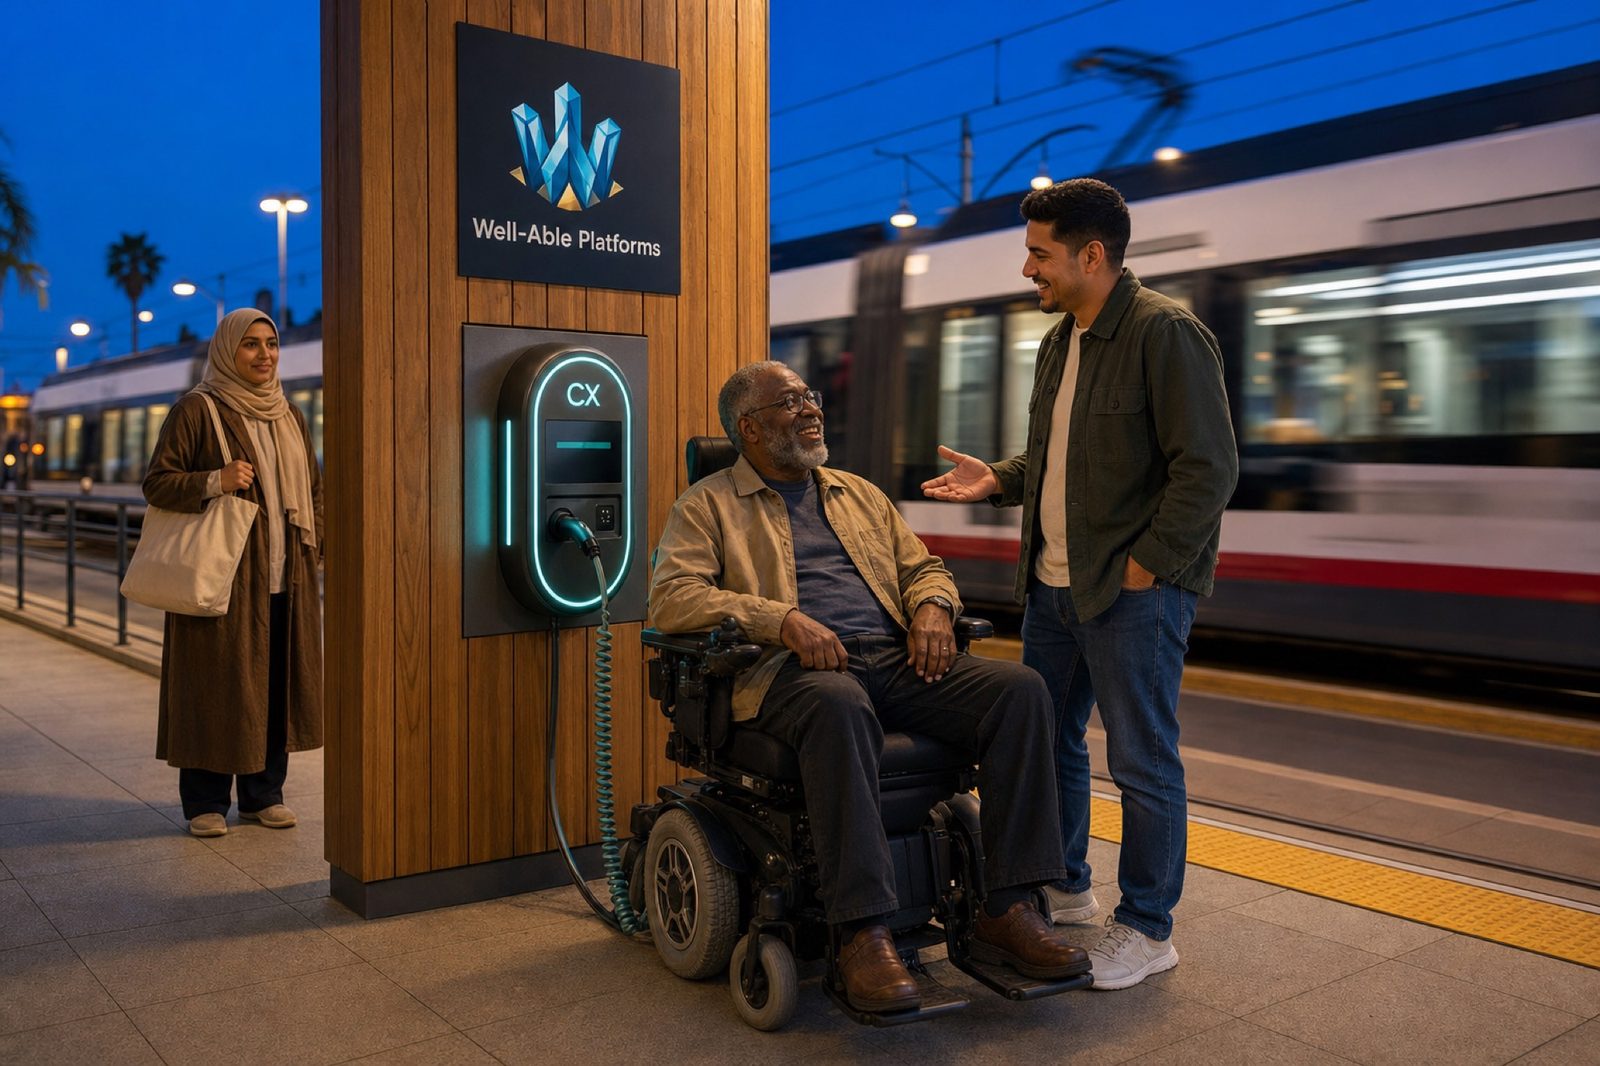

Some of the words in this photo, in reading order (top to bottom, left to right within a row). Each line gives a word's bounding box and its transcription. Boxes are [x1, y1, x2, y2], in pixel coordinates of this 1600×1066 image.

[472, 217, 572, 248] Well-Able
[578, 230, 661, 257] Platforms
[567, 382, 600, 407] CX
